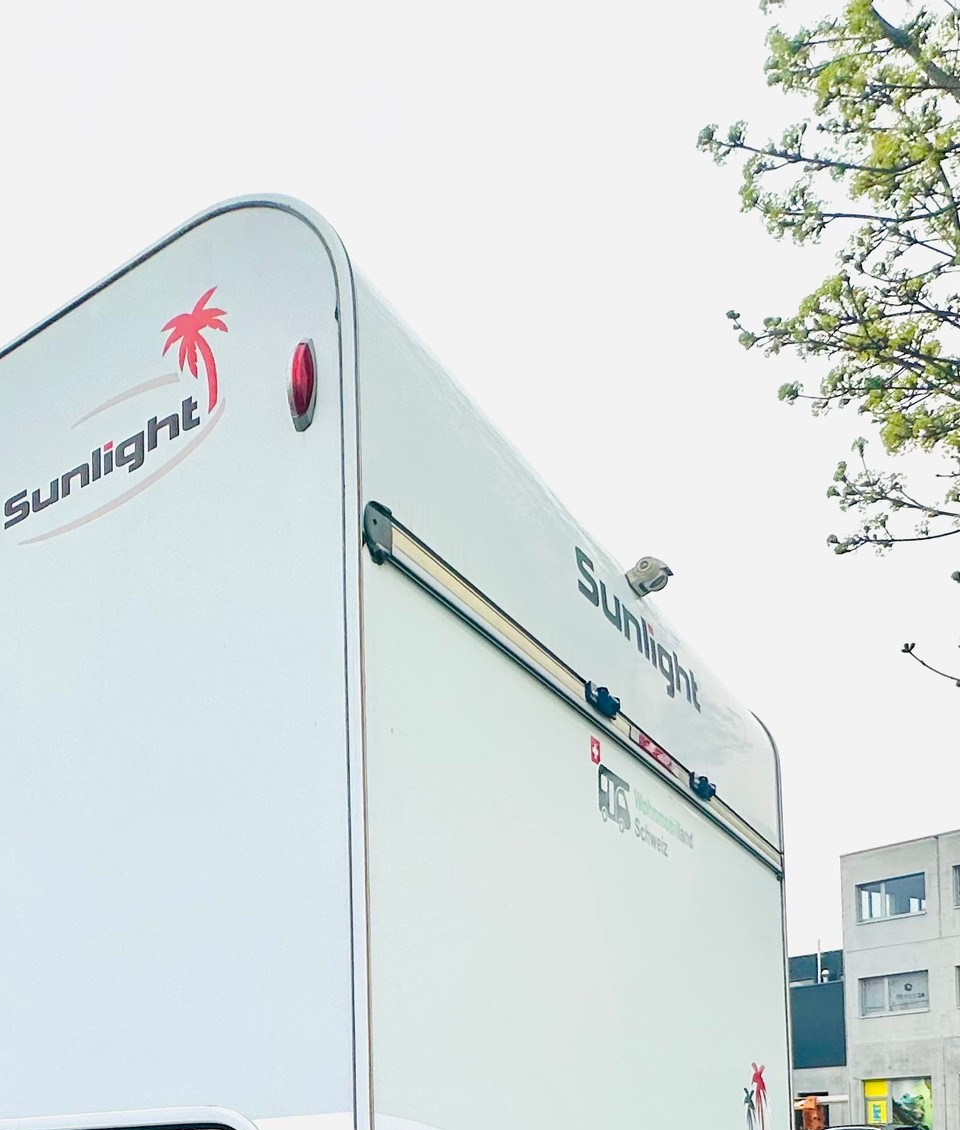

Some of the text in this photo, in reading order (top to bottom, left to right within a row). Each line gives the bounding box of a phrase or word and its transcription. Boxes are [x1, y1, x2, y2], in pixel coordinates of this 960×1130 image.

[4, 396, 200, 530] Sunlight
[575, 546, 702, 714] Sunlight
[634, 817, 668, 857] Schweiz
